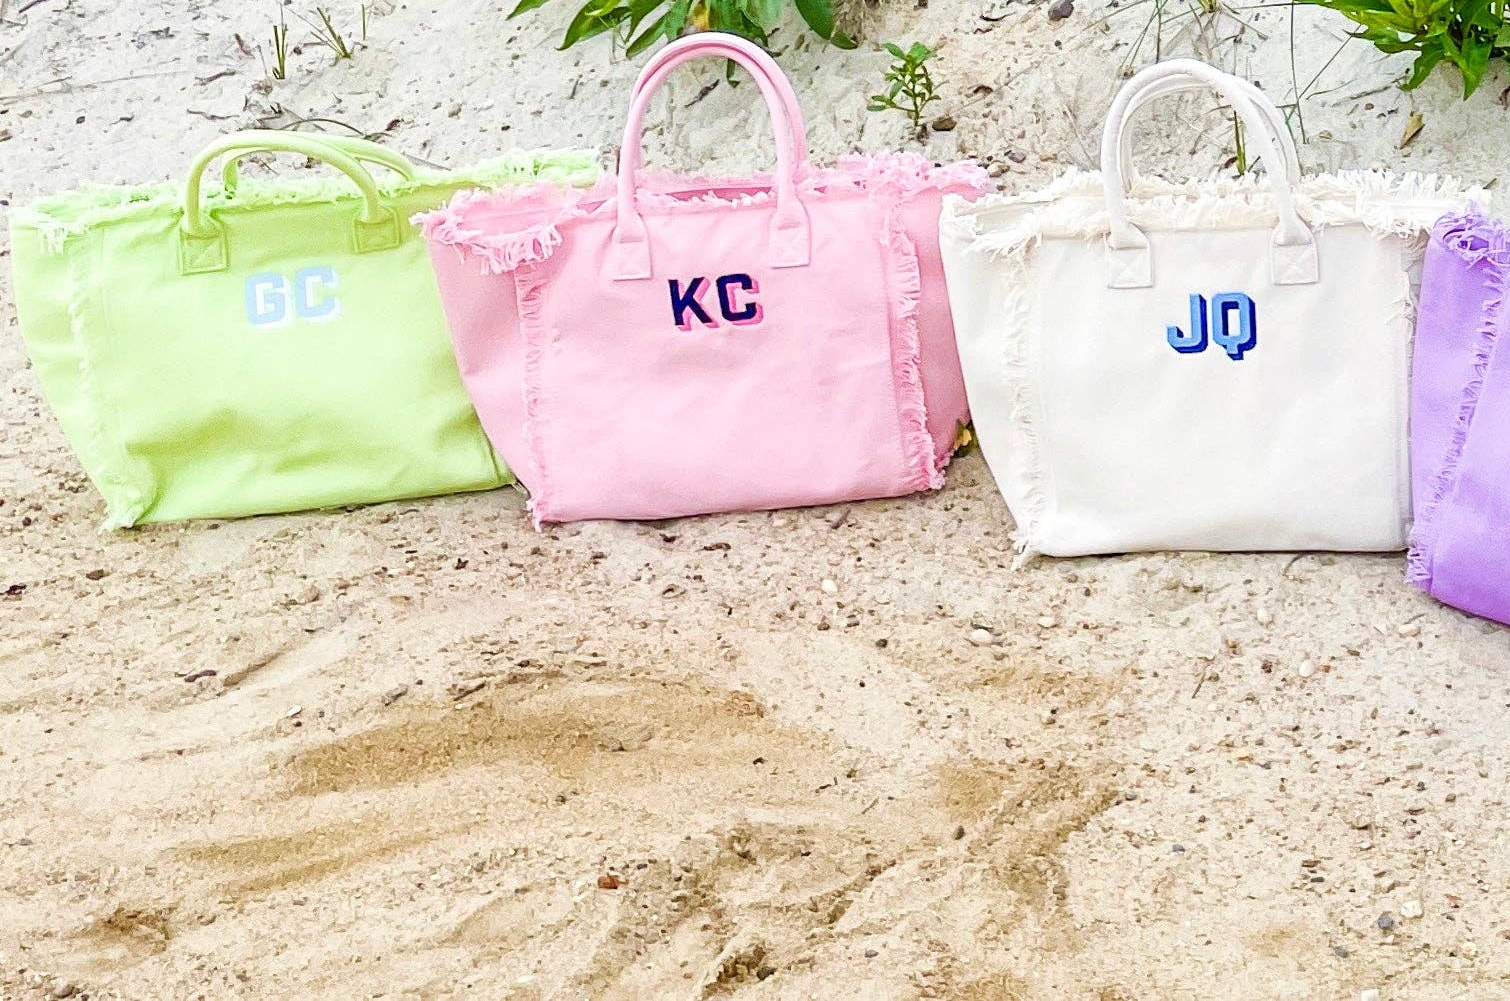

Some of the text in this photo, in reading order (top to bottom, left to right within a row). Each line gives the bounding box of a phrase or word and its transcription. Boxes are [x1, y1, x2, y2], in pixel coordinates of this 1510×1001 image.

[246, 266, 342, 329] GC
[668, 273, 764, 331] KC
[1167, 292, 1257, 361] JQ
